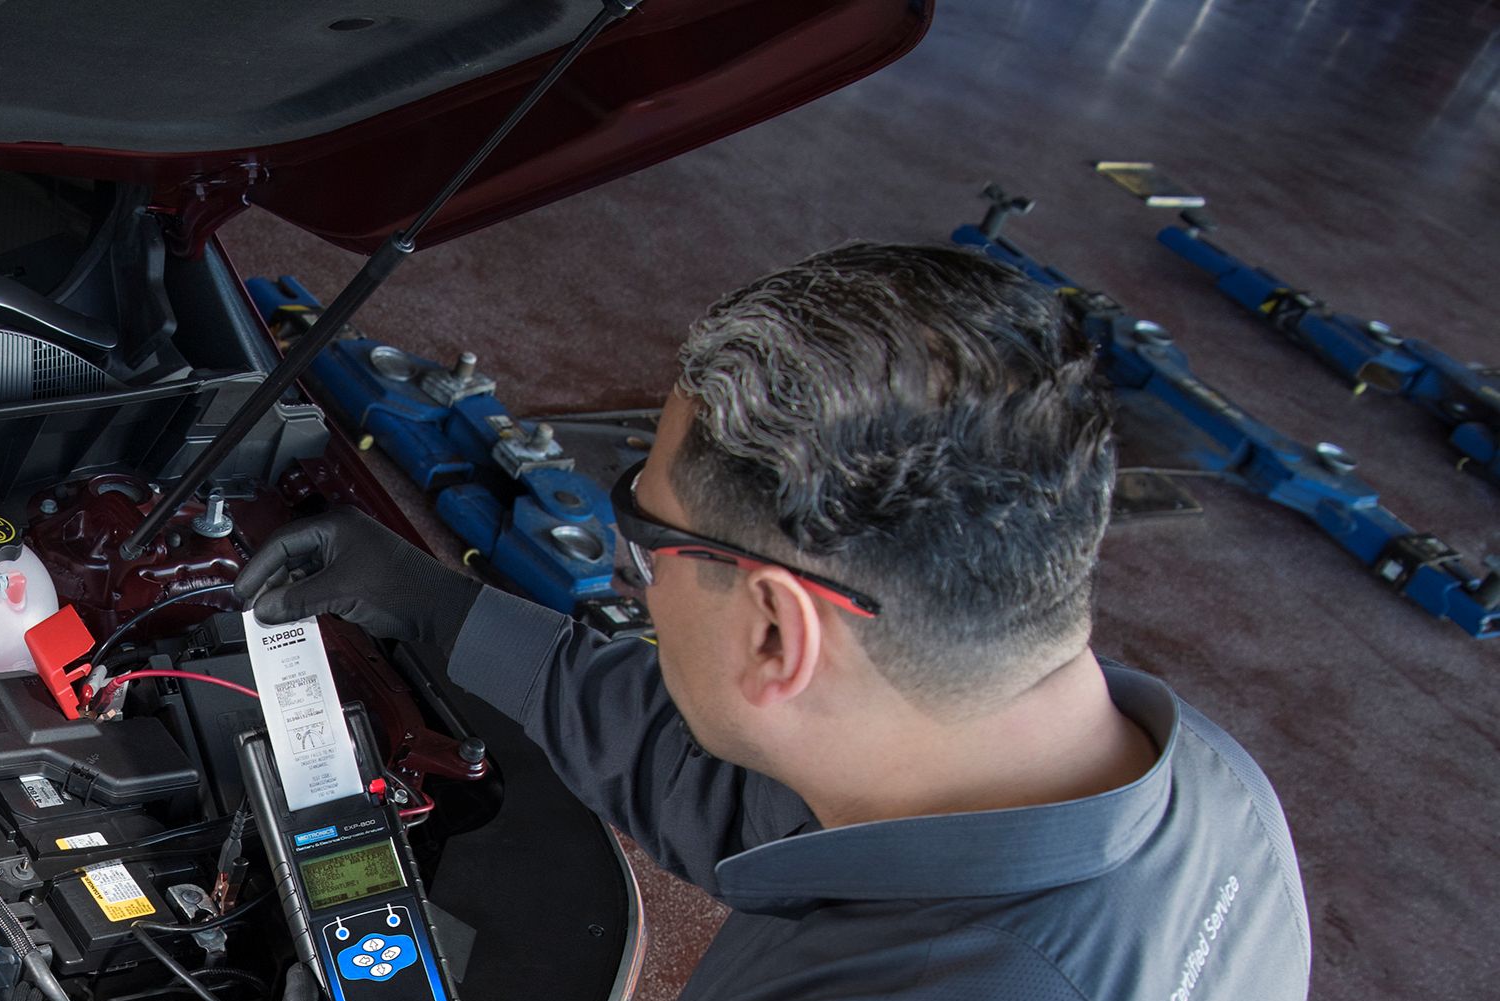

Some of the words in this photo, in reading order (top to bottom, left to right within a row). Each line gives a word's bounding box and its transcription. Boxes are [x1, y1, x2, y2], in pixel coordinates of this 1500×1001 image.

[262, 627, 305, 646] EXP800
[344, 819, 376, 832] EXP-800
[1203, 874, 1240, 940] Service
